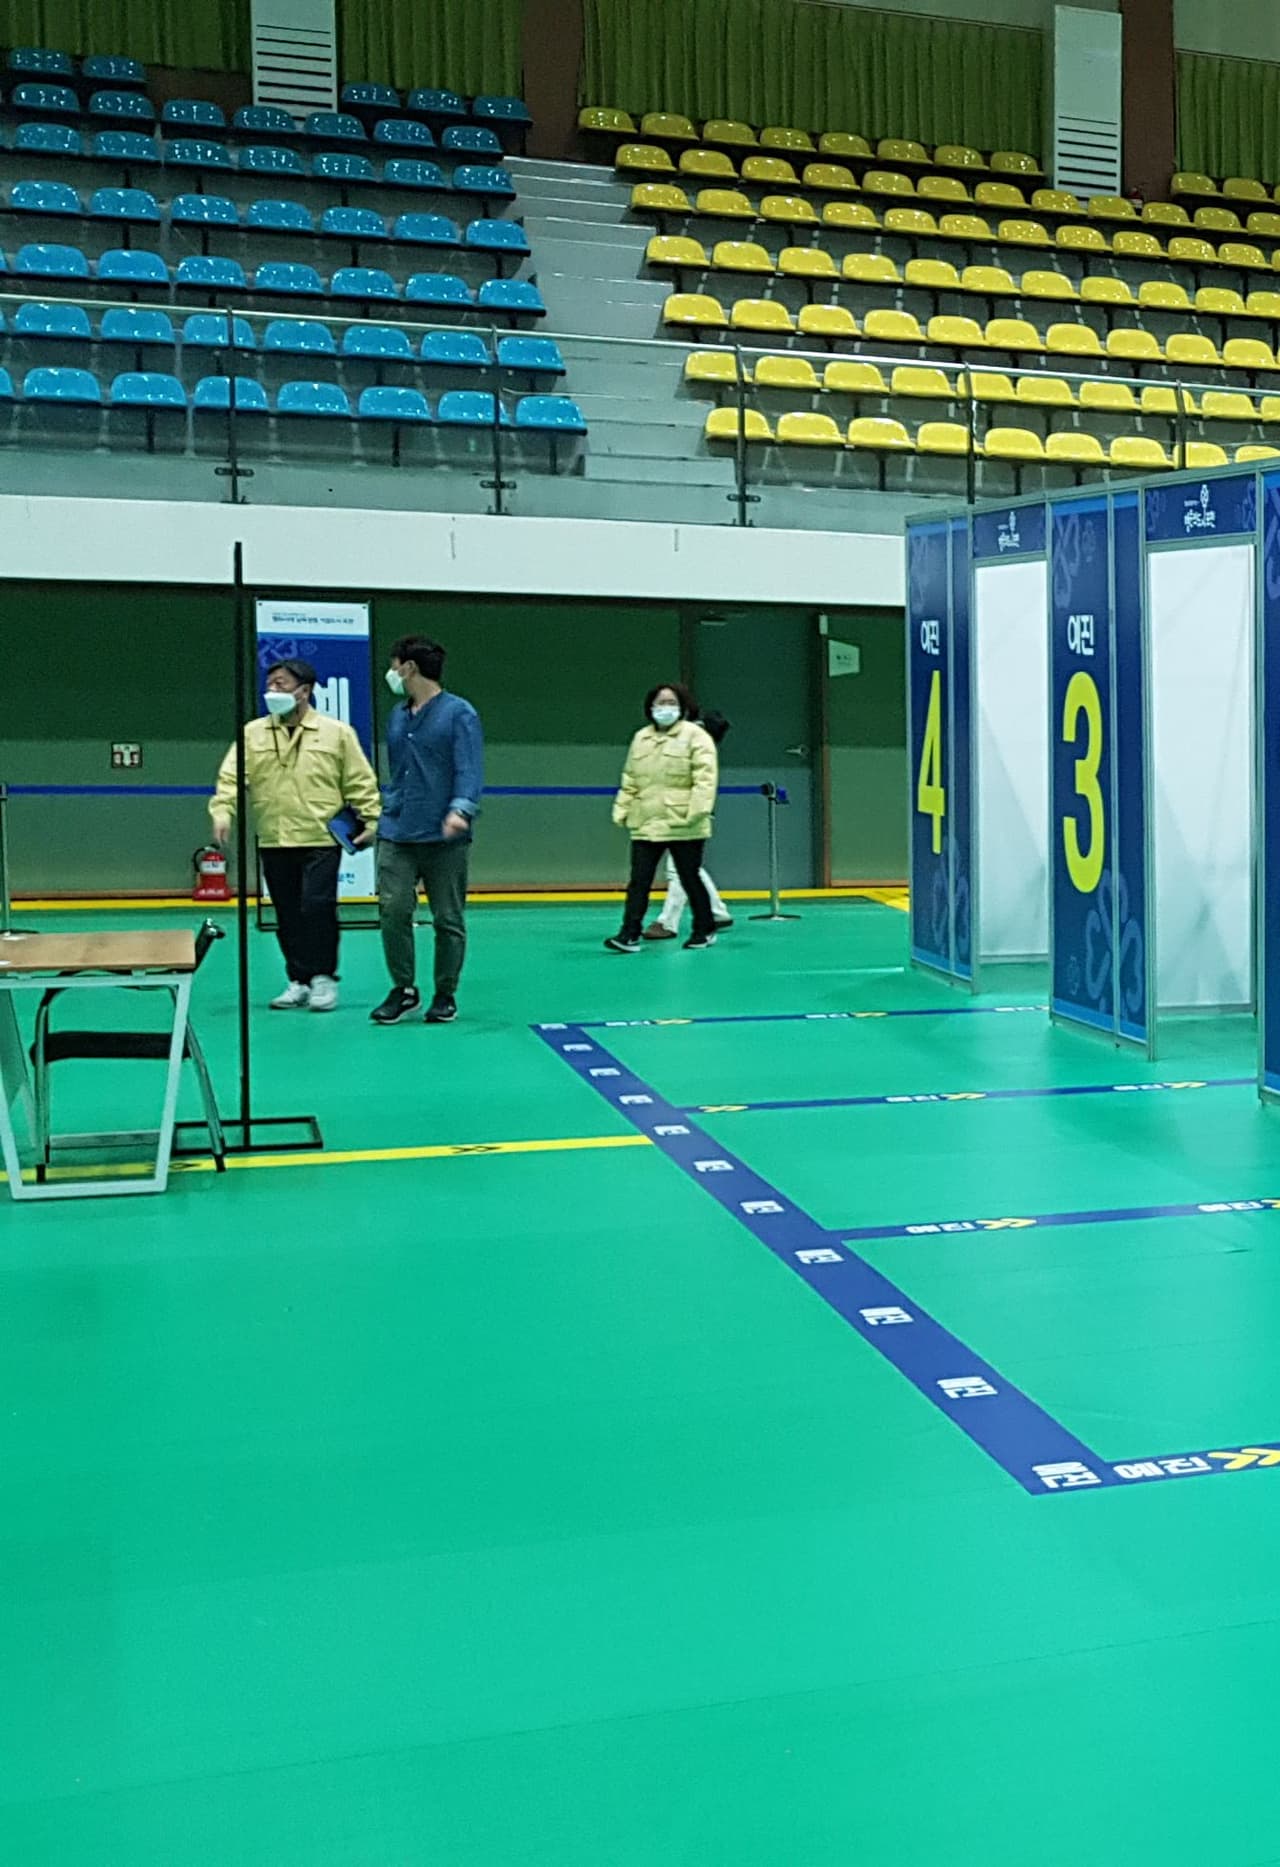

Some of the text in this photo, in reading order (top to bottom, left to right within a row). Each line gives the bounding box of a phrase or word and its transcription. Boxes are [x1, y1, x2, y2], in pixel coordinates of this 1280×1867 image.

[920, 619, 940, 656] 예진
[1067, 614, 1094, 656] 예진
[917, 671, 945, 854] 4
[1063, 672, 1104, 893] 3
[1113, 1456, 1213, 1480] 예진
